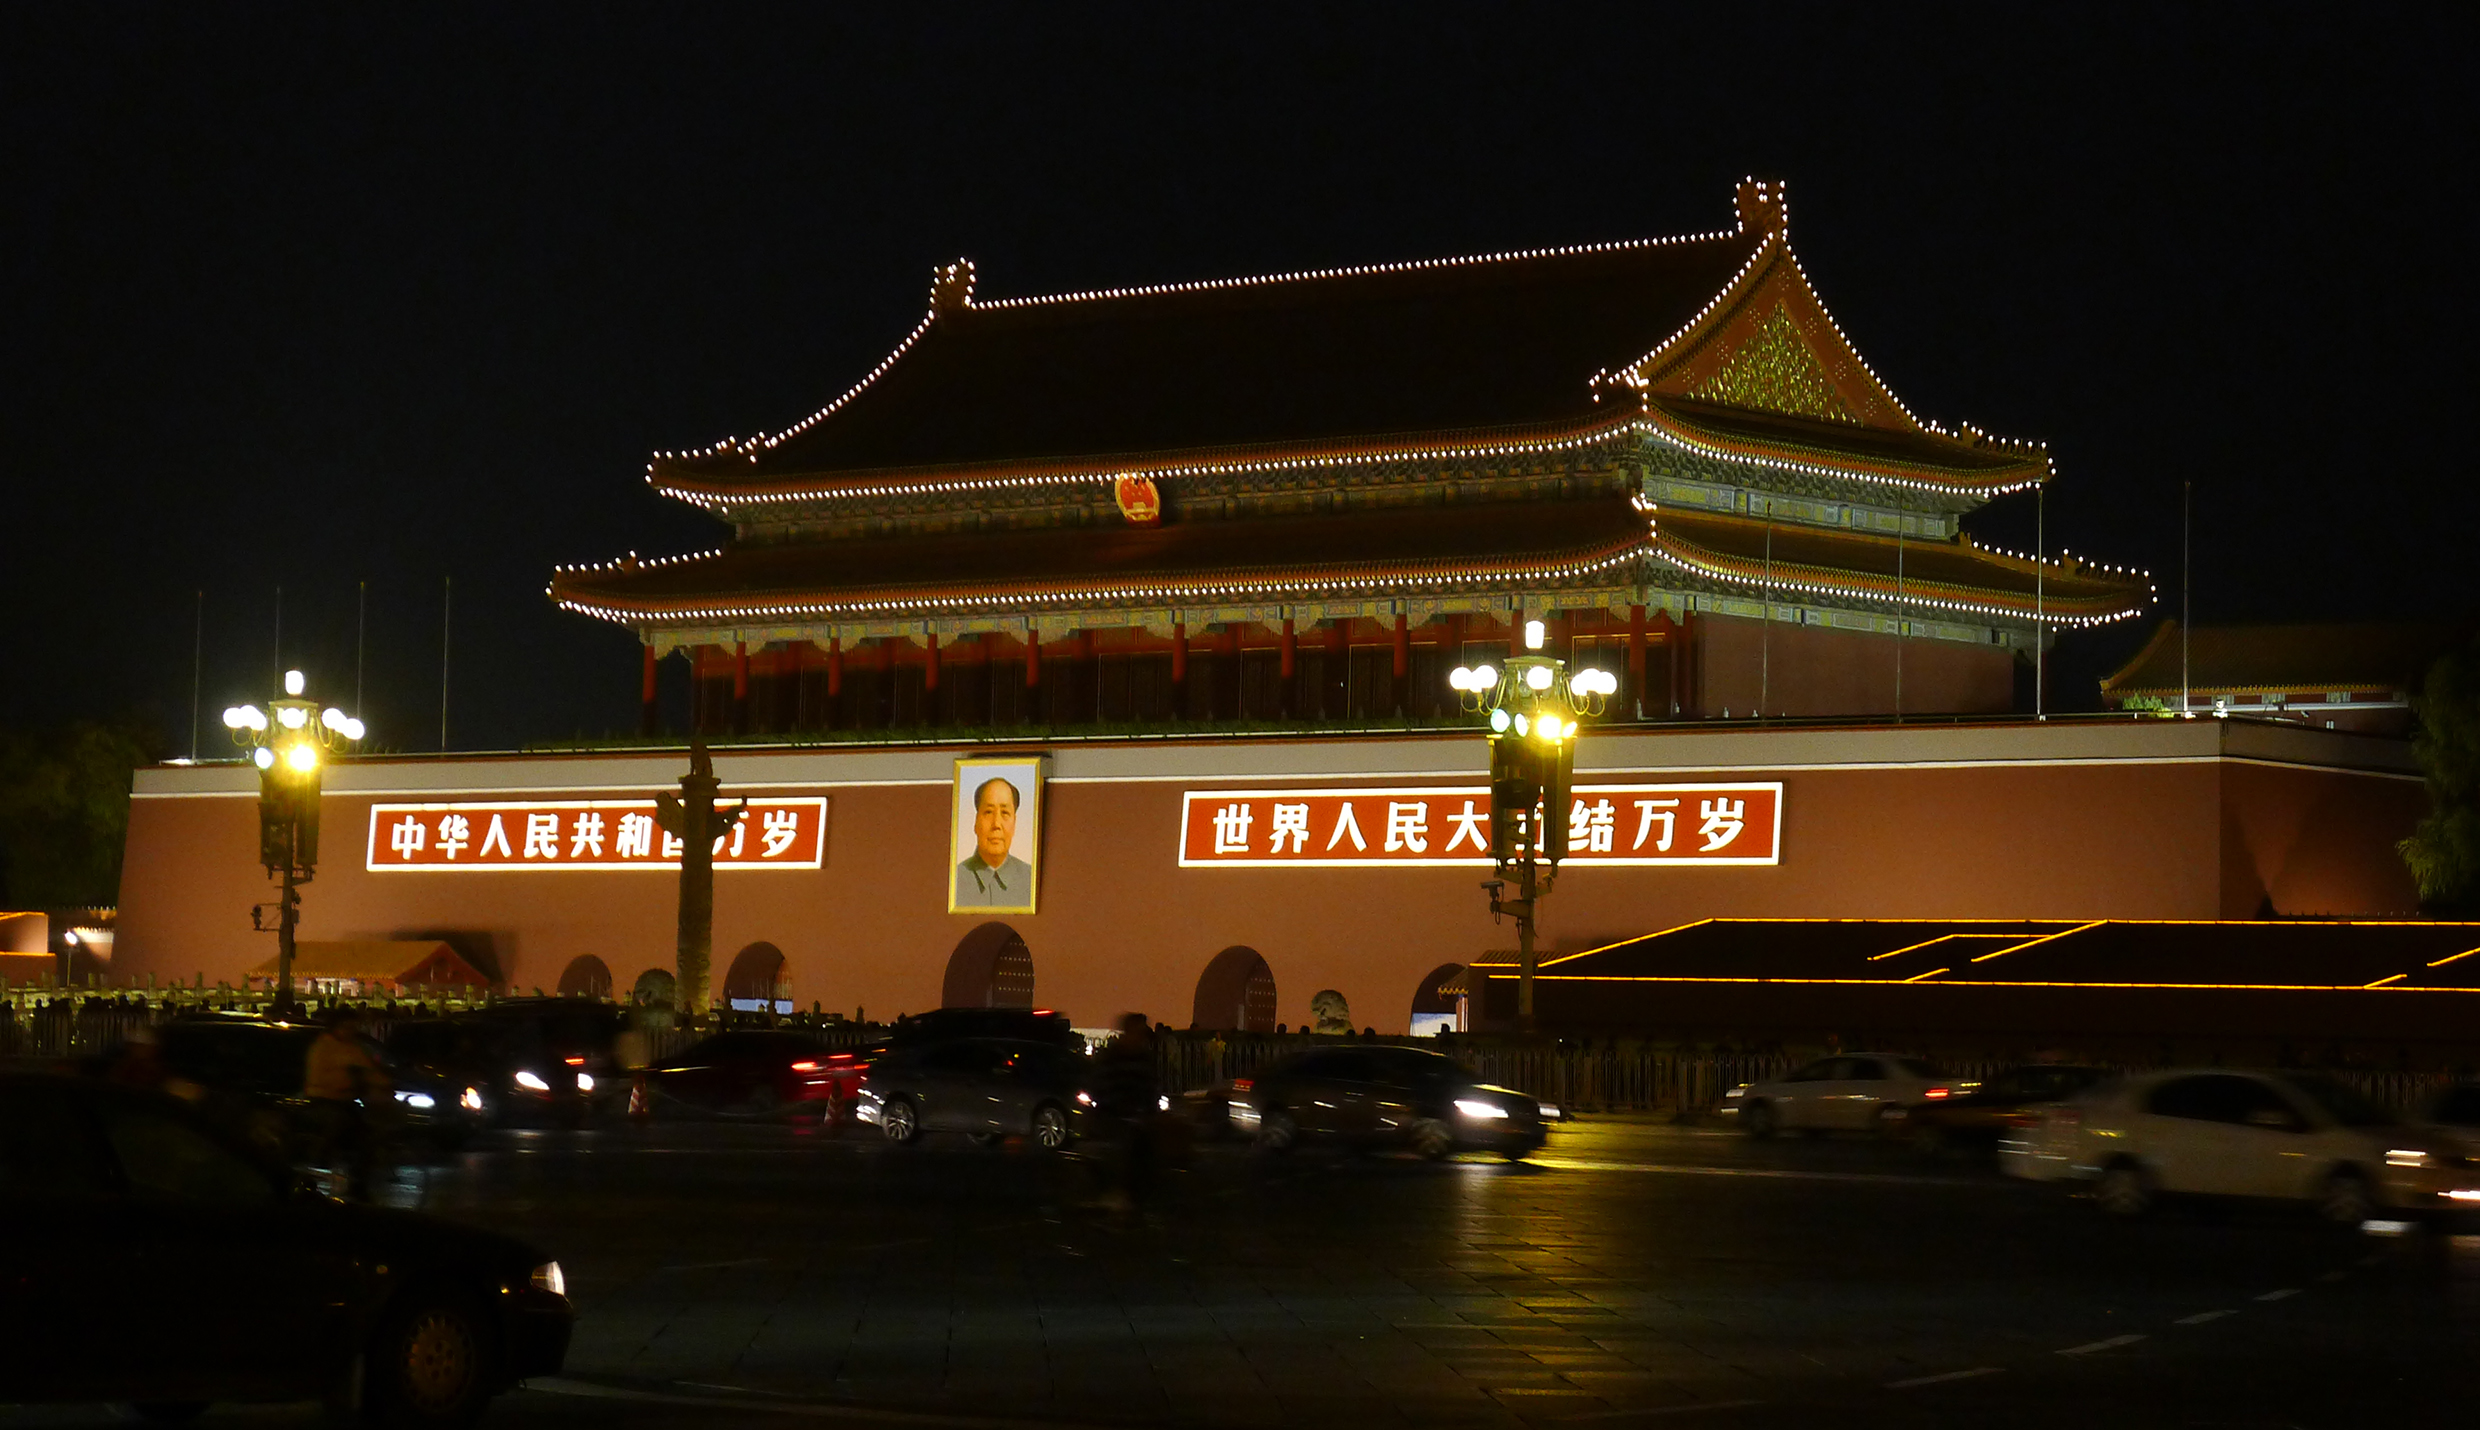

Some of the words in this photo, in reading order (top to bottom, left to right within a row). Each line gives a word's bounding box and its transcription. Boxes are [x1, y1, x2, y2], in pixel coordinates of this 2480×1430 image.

[391, 809, 798, 860] 中华人民共和万岁
